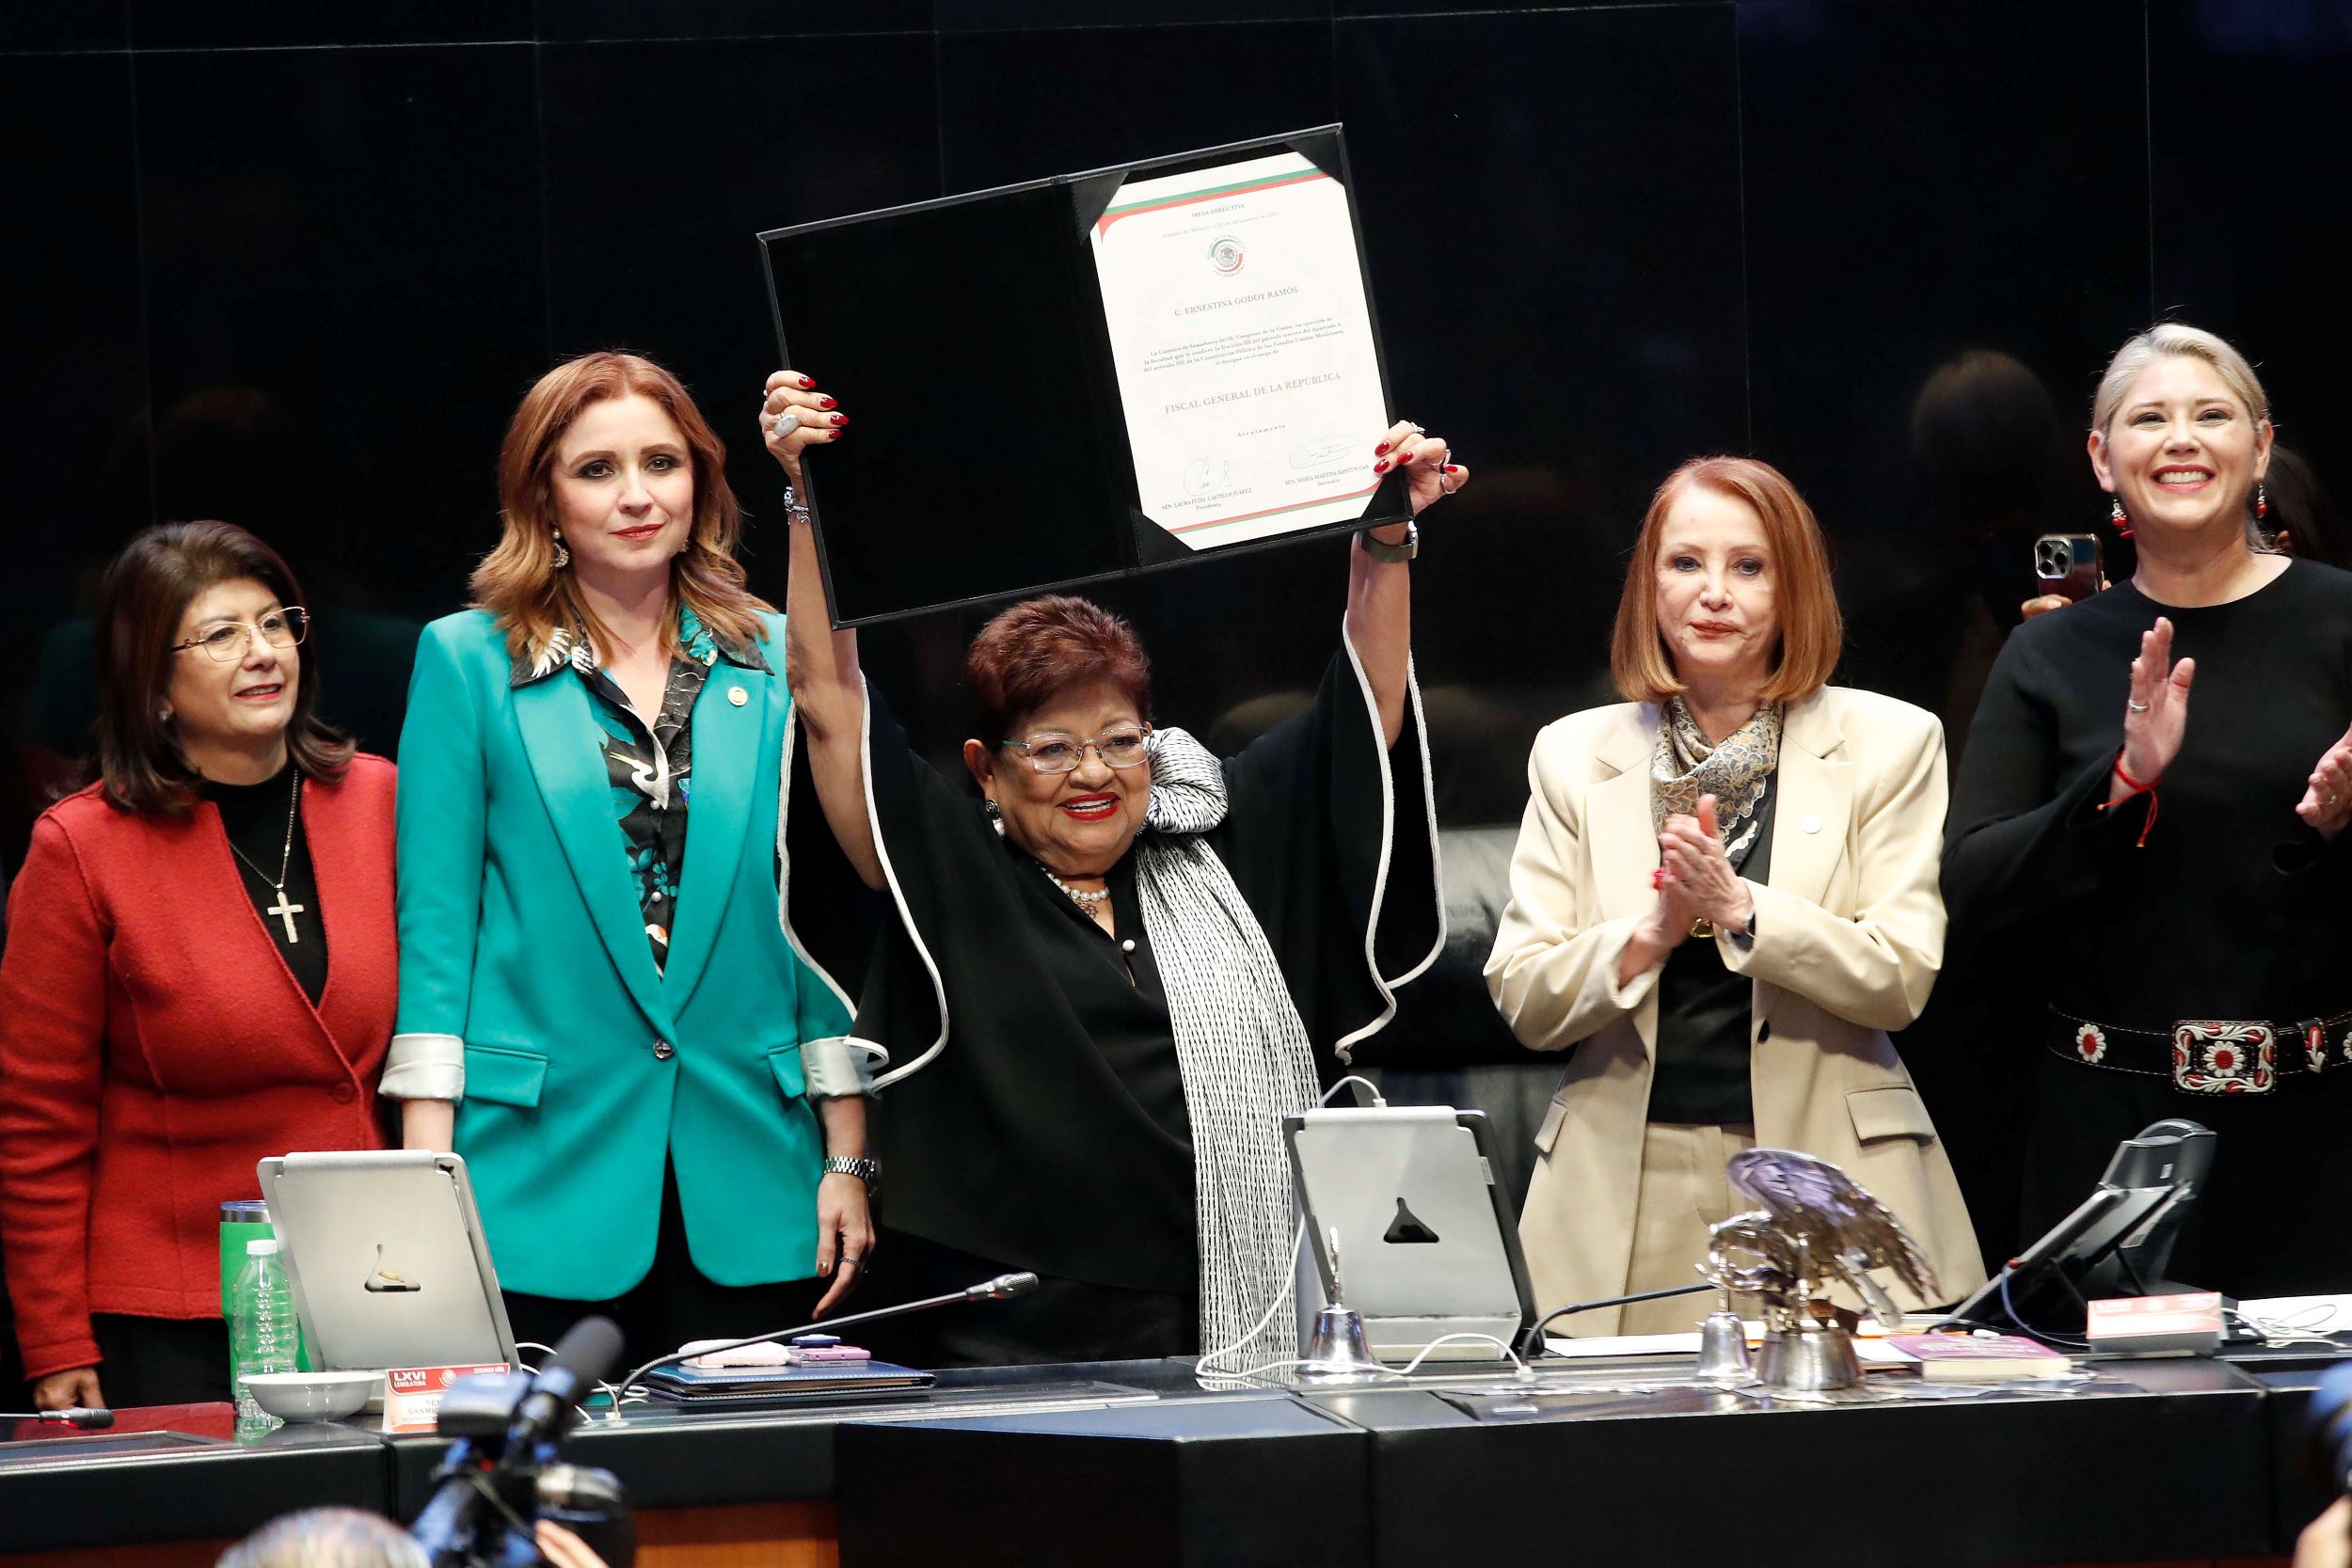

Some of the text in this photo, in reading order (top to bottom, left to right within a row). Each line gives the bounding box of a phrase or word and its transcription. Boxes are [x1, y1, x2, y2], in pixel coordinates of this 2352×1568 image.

[1210, 203, 1245, 214] DIRECTIVA
[1184, 300, 1232, 314] ERNESTINA
[1233, 293, 1265, 305] GODOY
[1266, 287, 1297, 298] RAMOS
[1165, 370, 1341, 413] FISCAL GENERAL DE LA REPÚBLICA
[1207, 492, 1232, 501] CASTILLO
[394, 1371, 426, 1381] LXVI
